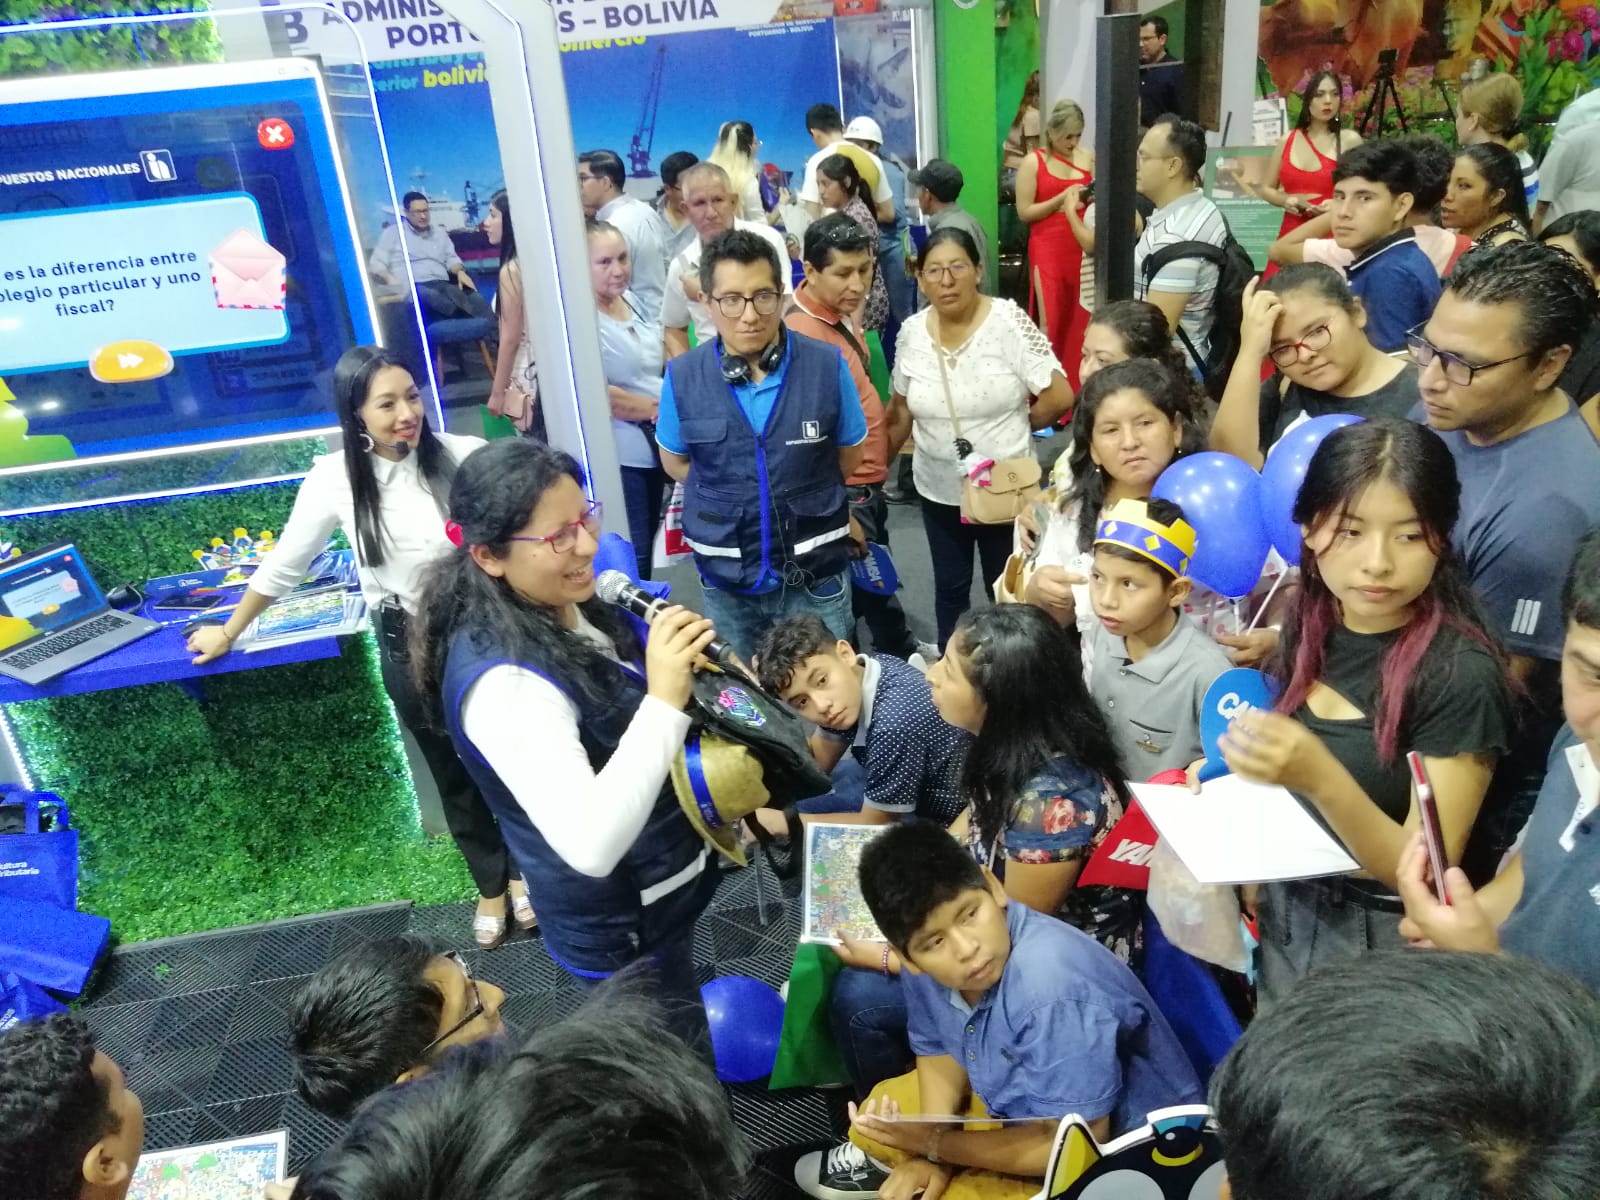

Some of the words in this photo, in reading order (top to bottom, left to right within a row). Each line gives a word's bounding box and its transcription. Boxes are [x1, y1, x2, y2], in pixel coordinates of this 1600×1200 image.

[386, 21, 481, 49] PORT
[603, 0, 719, 29] BOLIVIA
[56, 163, 141, 181] NACIONALES
[4, 270, 25, 281] es
[29, 265, 46, 279] la
[52, 256, 145, 277] diferencia
[150, 252, 197, 266] entre
[59, 276, 147, 299] particular
[151, 277, 162, 290] y
[168, 271, 201, 285] uno
[56, 299, 115, 317] fiscal?
